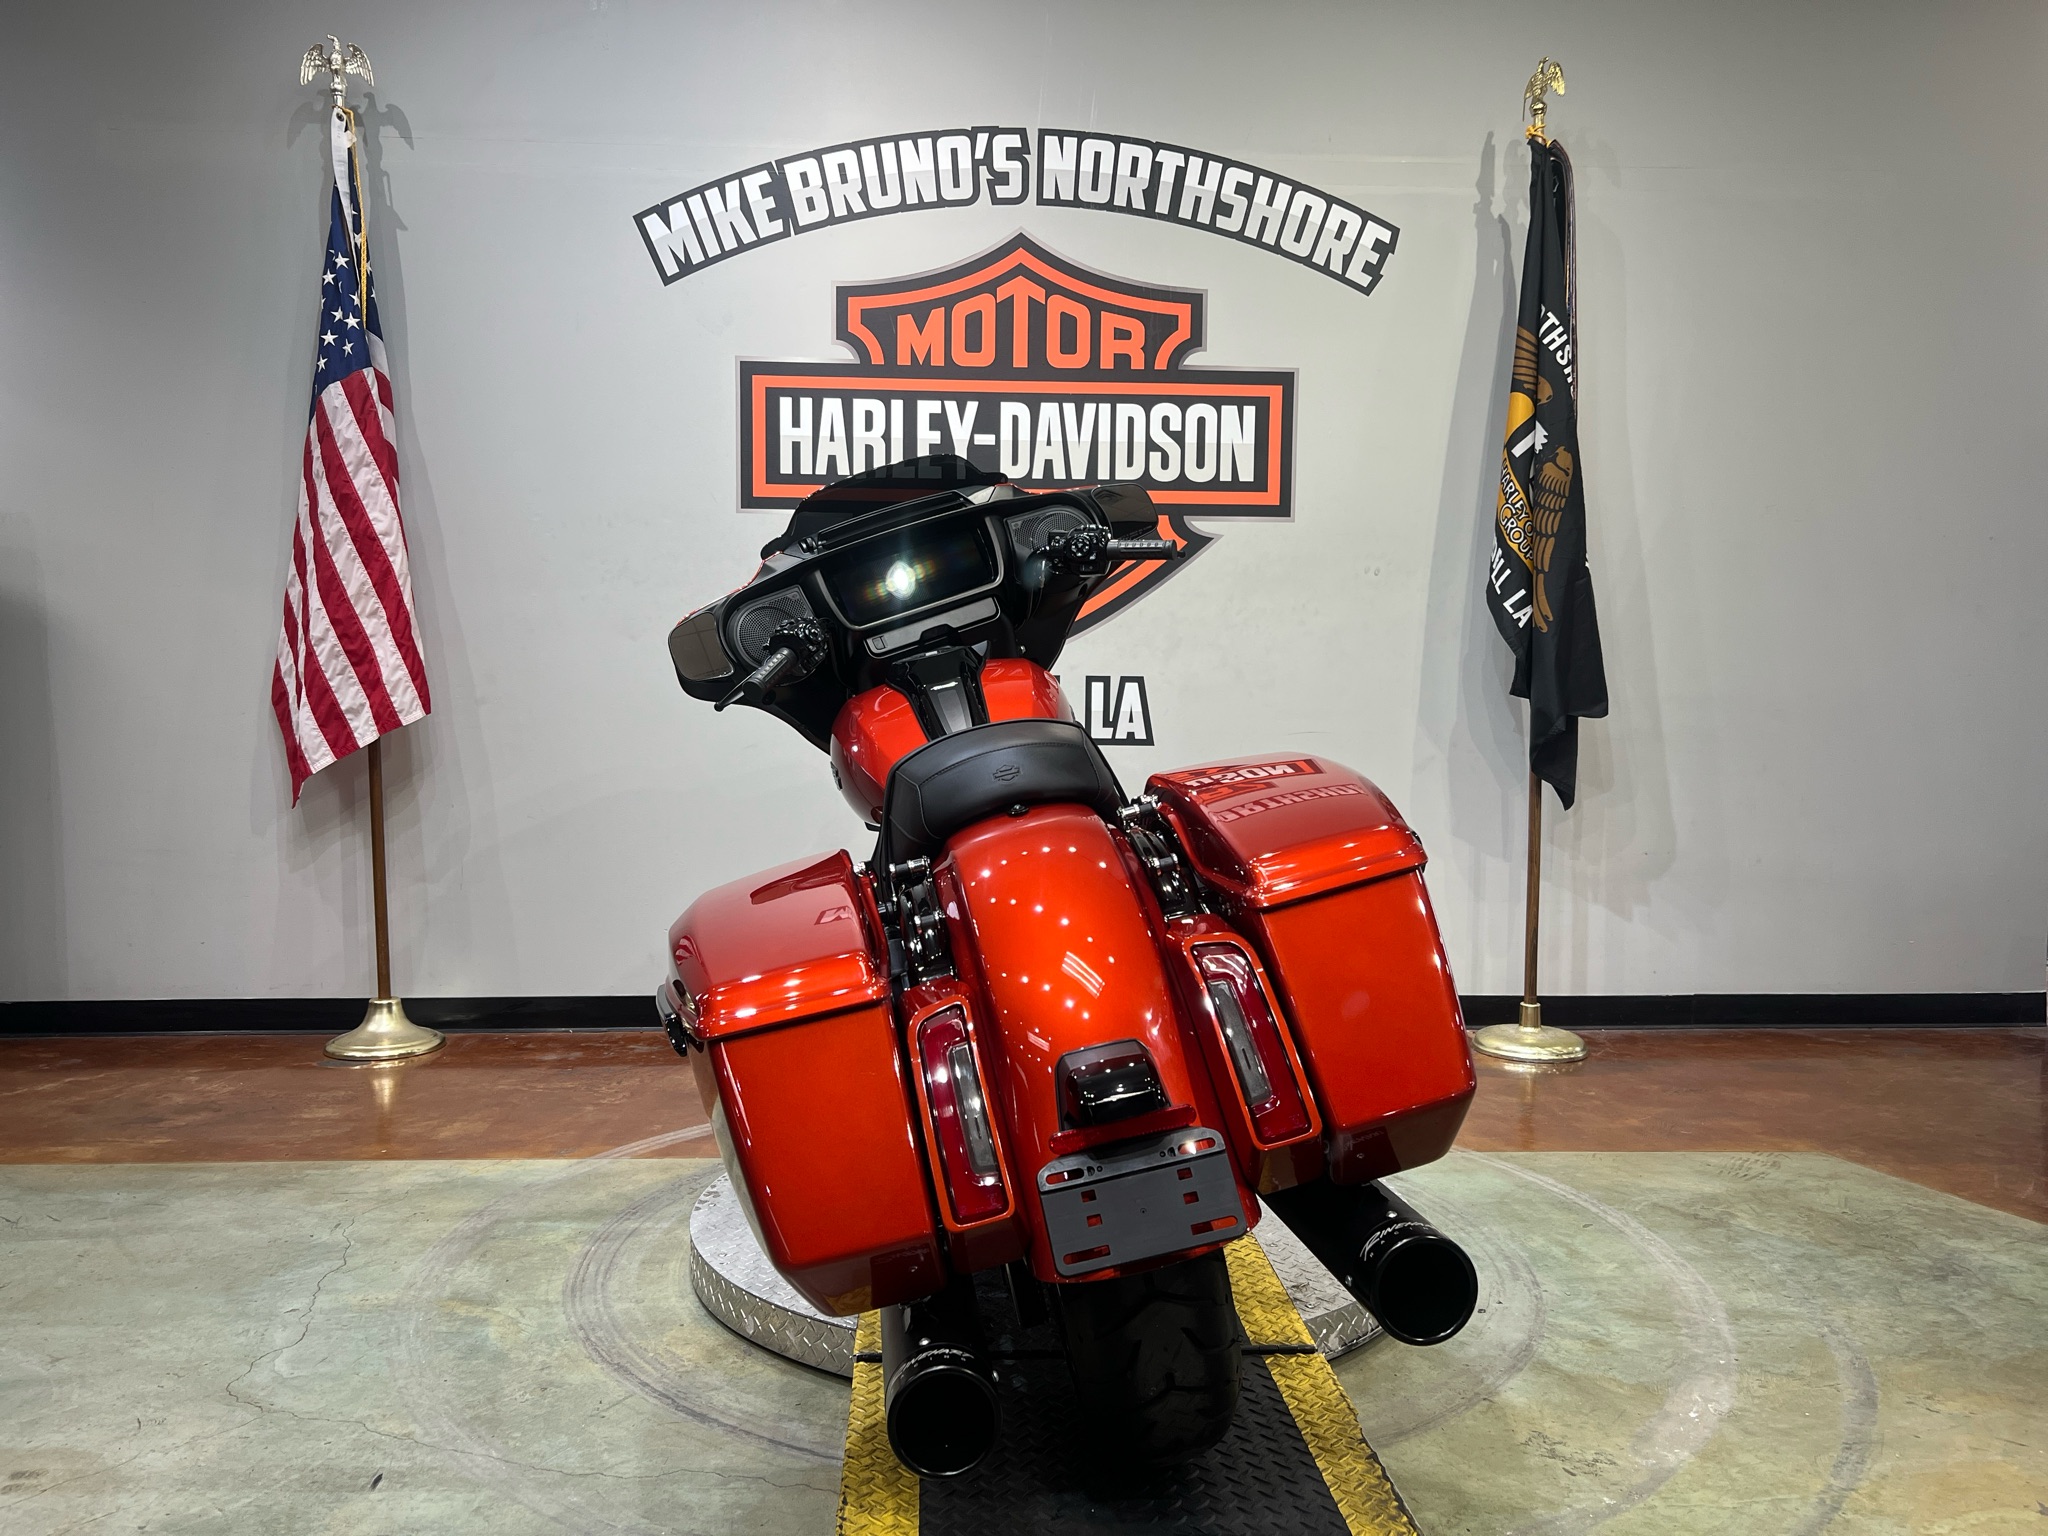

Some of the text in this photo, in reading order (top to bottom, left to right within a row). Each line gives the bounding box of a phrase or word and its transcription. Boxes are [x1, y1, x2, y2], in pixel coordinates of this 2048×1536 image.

[642, 132, 1393, 288] MIKE BRUNO'S NORTHSHORE
[897, 275, 1146, 370] MOTOR
[779, 396, 1256, 483] HARLEY-DAVIDSON
[1502, 588, 1534, 628] LA
[1091, 681, 1147, 740] LA
